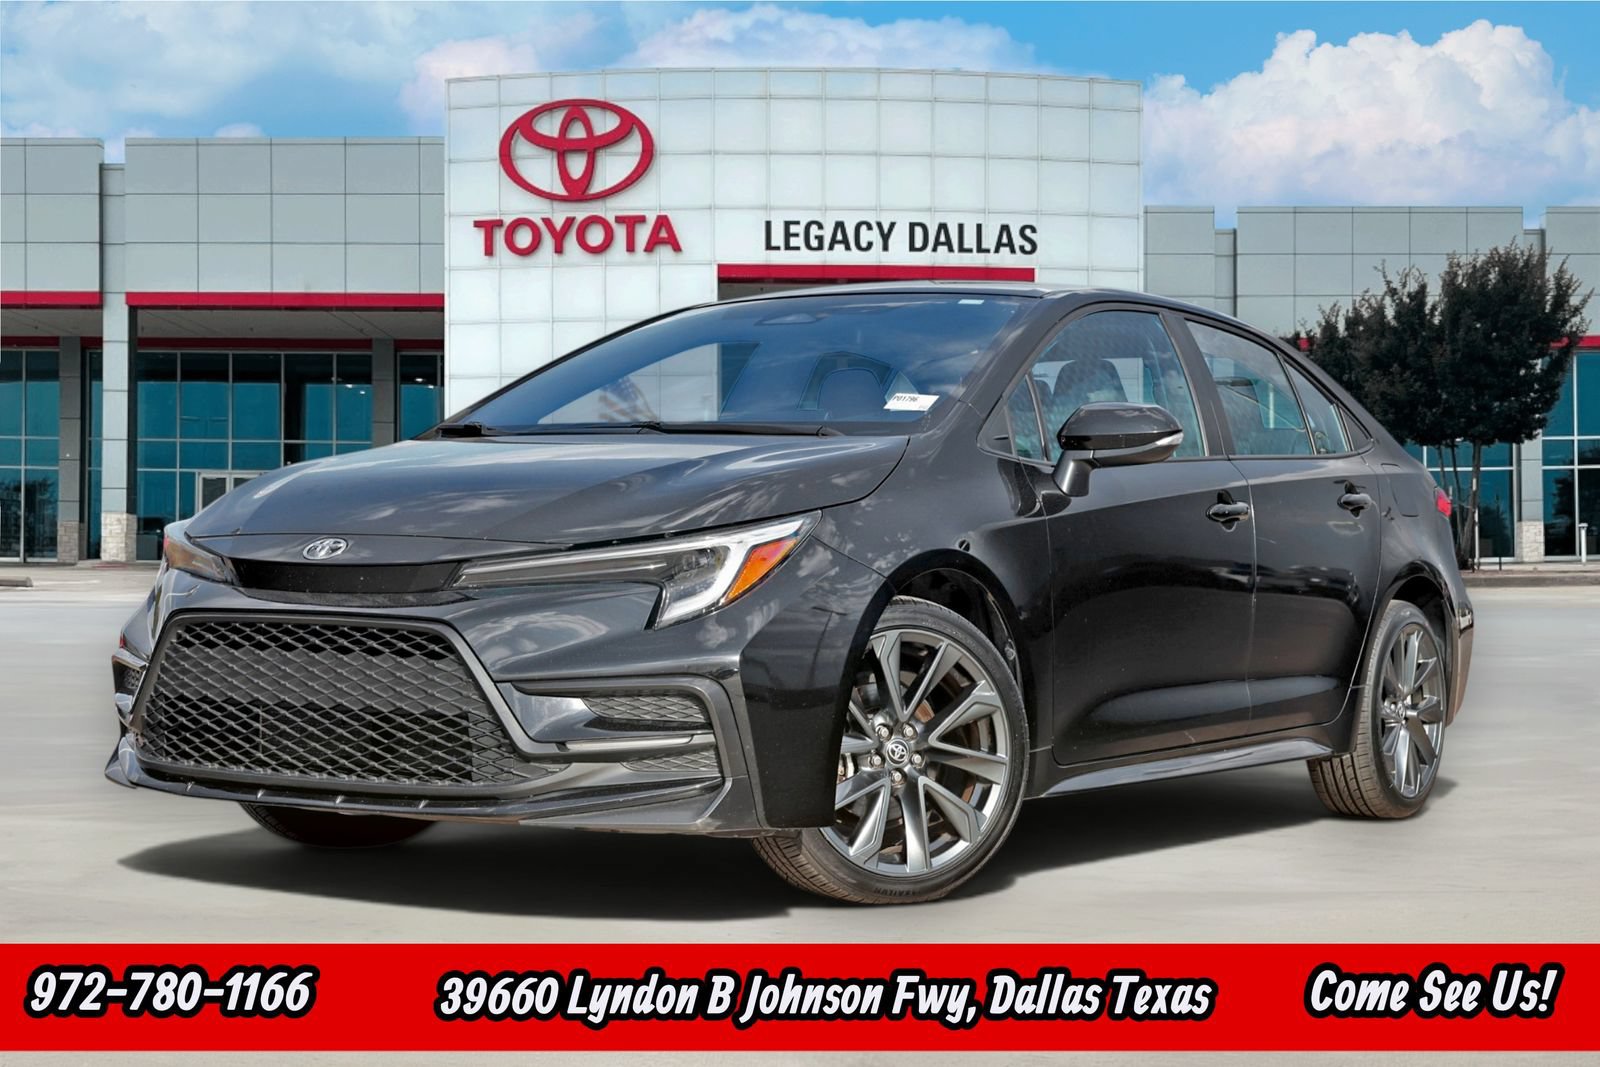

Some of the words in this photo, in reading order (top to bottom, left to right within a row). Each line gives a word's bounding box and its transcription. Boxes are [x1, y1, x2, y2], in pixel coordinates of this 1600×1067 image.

[474, 214, 682, 256] TOYOTA
[764, 219, 898, 252] LEGACY
[907, 220, 1039, 255] DALLAS
